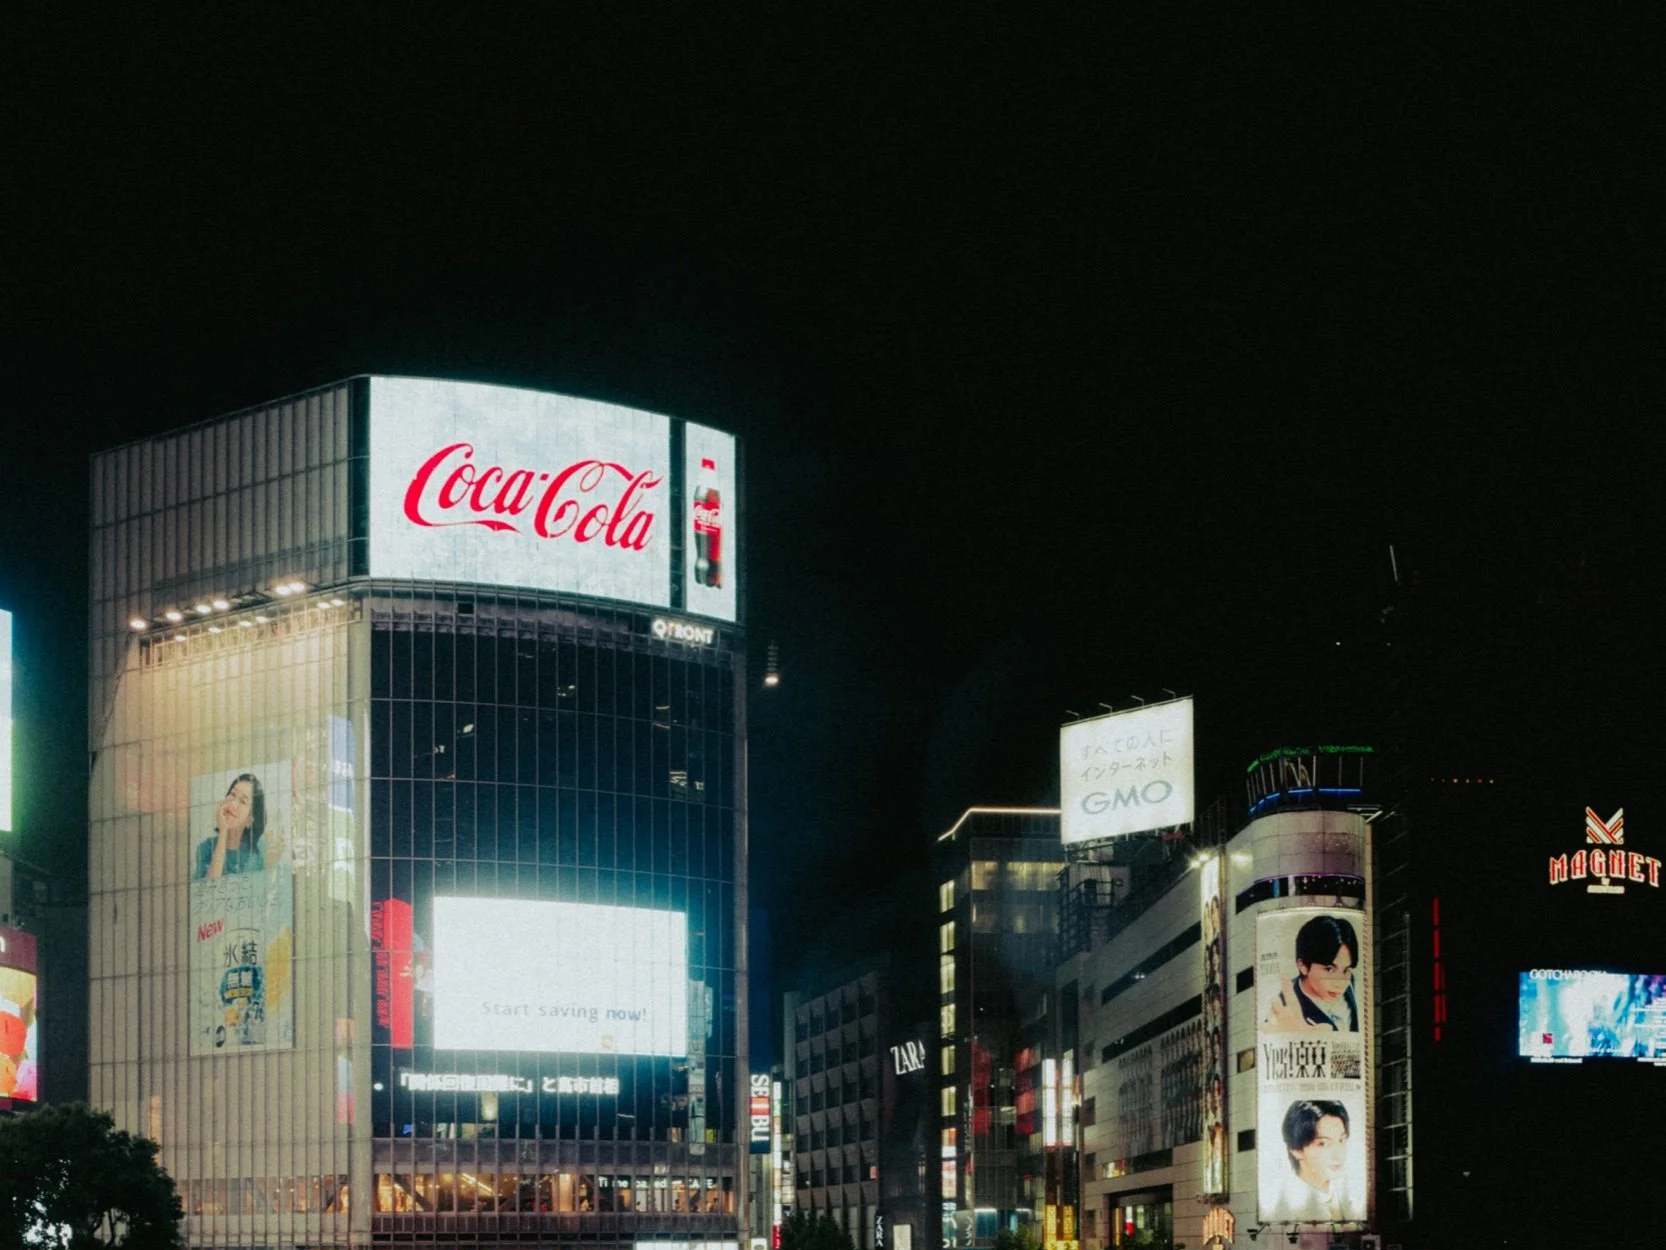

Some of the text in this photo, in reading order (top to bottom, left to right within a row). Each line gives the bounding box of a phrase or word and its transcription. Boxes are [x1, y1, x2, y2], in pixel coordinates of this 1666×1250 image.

[402, 441, 665, 552] Coca-Cola
[1081, 751, 1173, 781] インターネット
[1080, 780, 1173, 815] GMO
[1549, 848, 1662, 888] MAGNET
[196, 919, 224, 943] New
[223, 940, 258, 968] 氷結
[481, 1000, 647, 1023] Start saving now!
[751, 1074, 770, 1142] SEIBU
